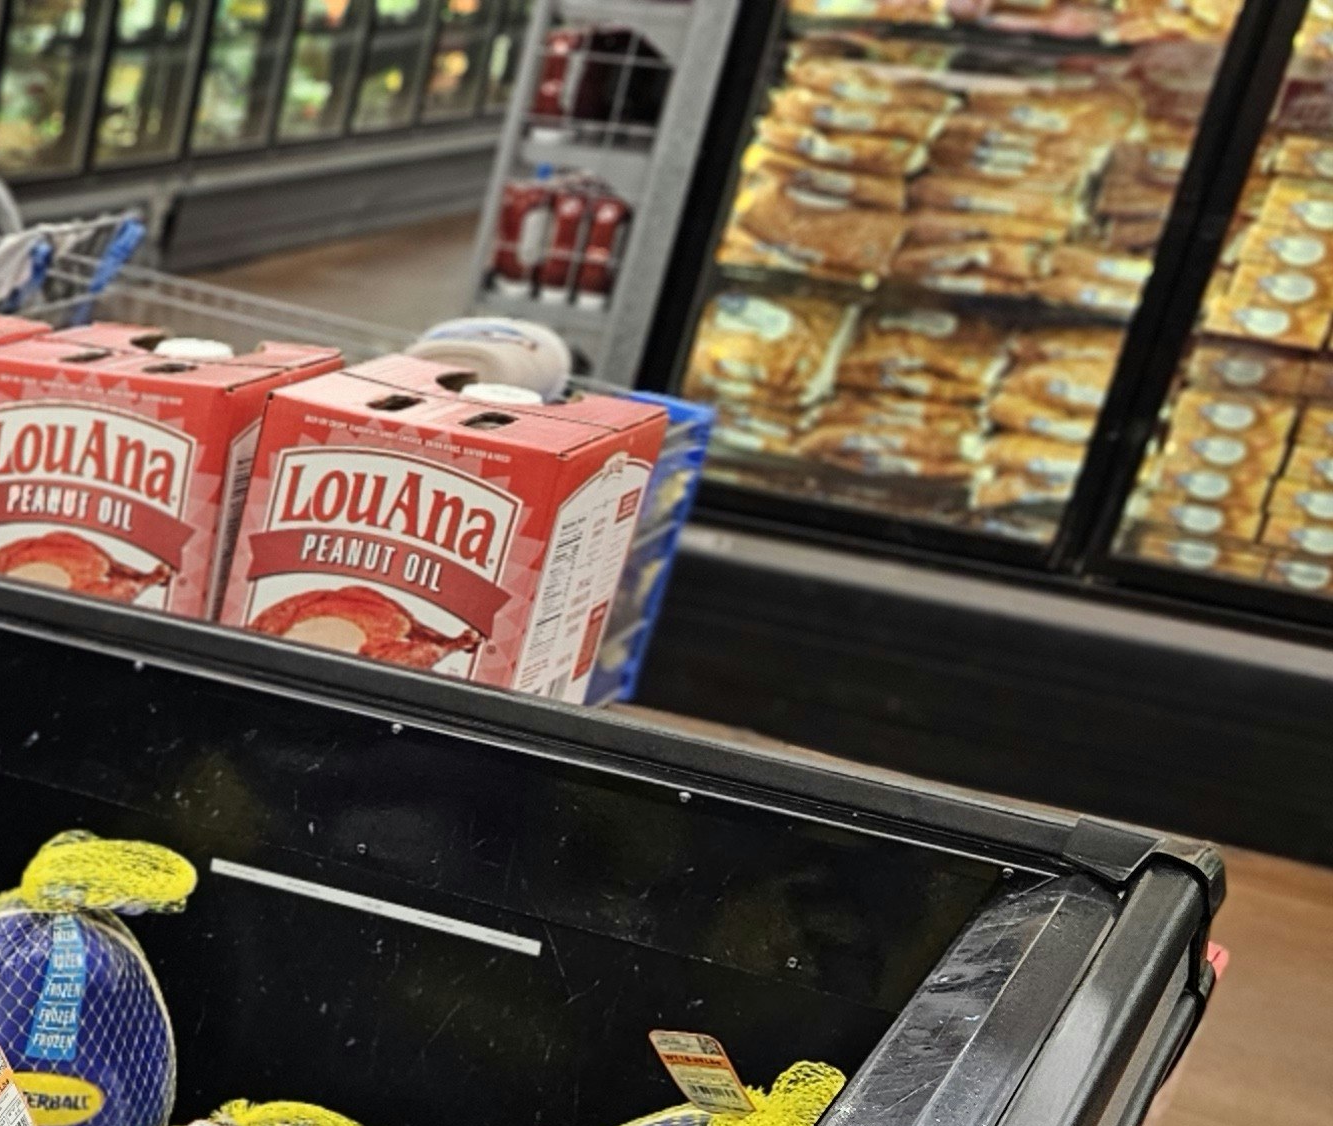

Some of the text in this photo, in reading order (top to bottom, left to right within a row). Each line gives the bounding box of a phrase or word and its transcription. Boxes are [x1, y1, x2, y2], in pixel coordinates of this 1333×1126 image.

[7, 483, 134, 532] PEANUT OIL
[280, 464, 497, 569] LouAna
[300, 532, 444, 593] PEANUT OIL
[37, 1006, 78, 1024] FROZEN
[32, 1032, 77, 1050] FROZEN
